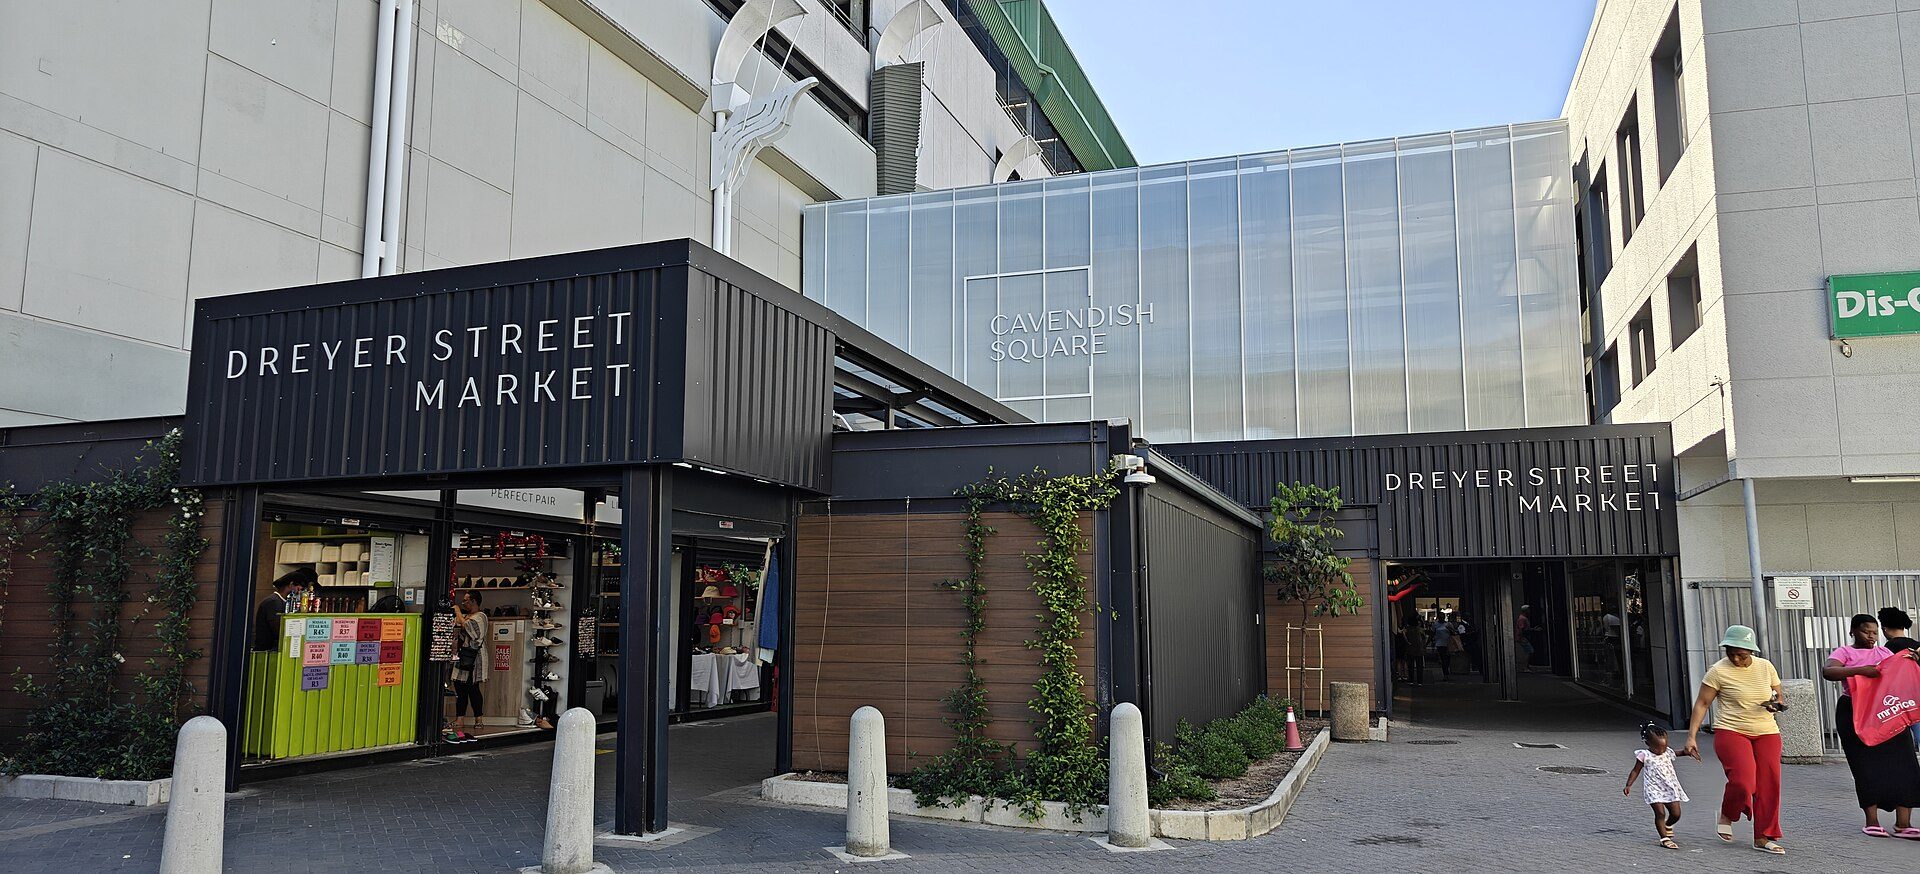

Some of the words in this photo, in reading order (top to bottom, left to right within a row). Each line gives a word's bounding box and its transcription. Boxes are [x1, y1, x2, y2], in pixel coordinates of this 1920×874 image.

[990, 302, 1155, 336] CAVENDISH
[227, 335, 408, 379] DREYER
[432, 311, 631, 361] STREET
[990, 333, 1108, 363] SQUARE
[415, 364, 630, 411] MARKET
[1385, 469, 1514, 491] DREYER
[1528, 463, 1658, 486] STREET
[491, 488, 534, 503] PERFECT
[535, 494, 556, 506] PAIR
[1519, 492, 1660, 513] MARKET
[496, 647, 510, 655] SALE
[1876, 708, 1891, 720] mr
[1890, 699, 1916, 715] price
